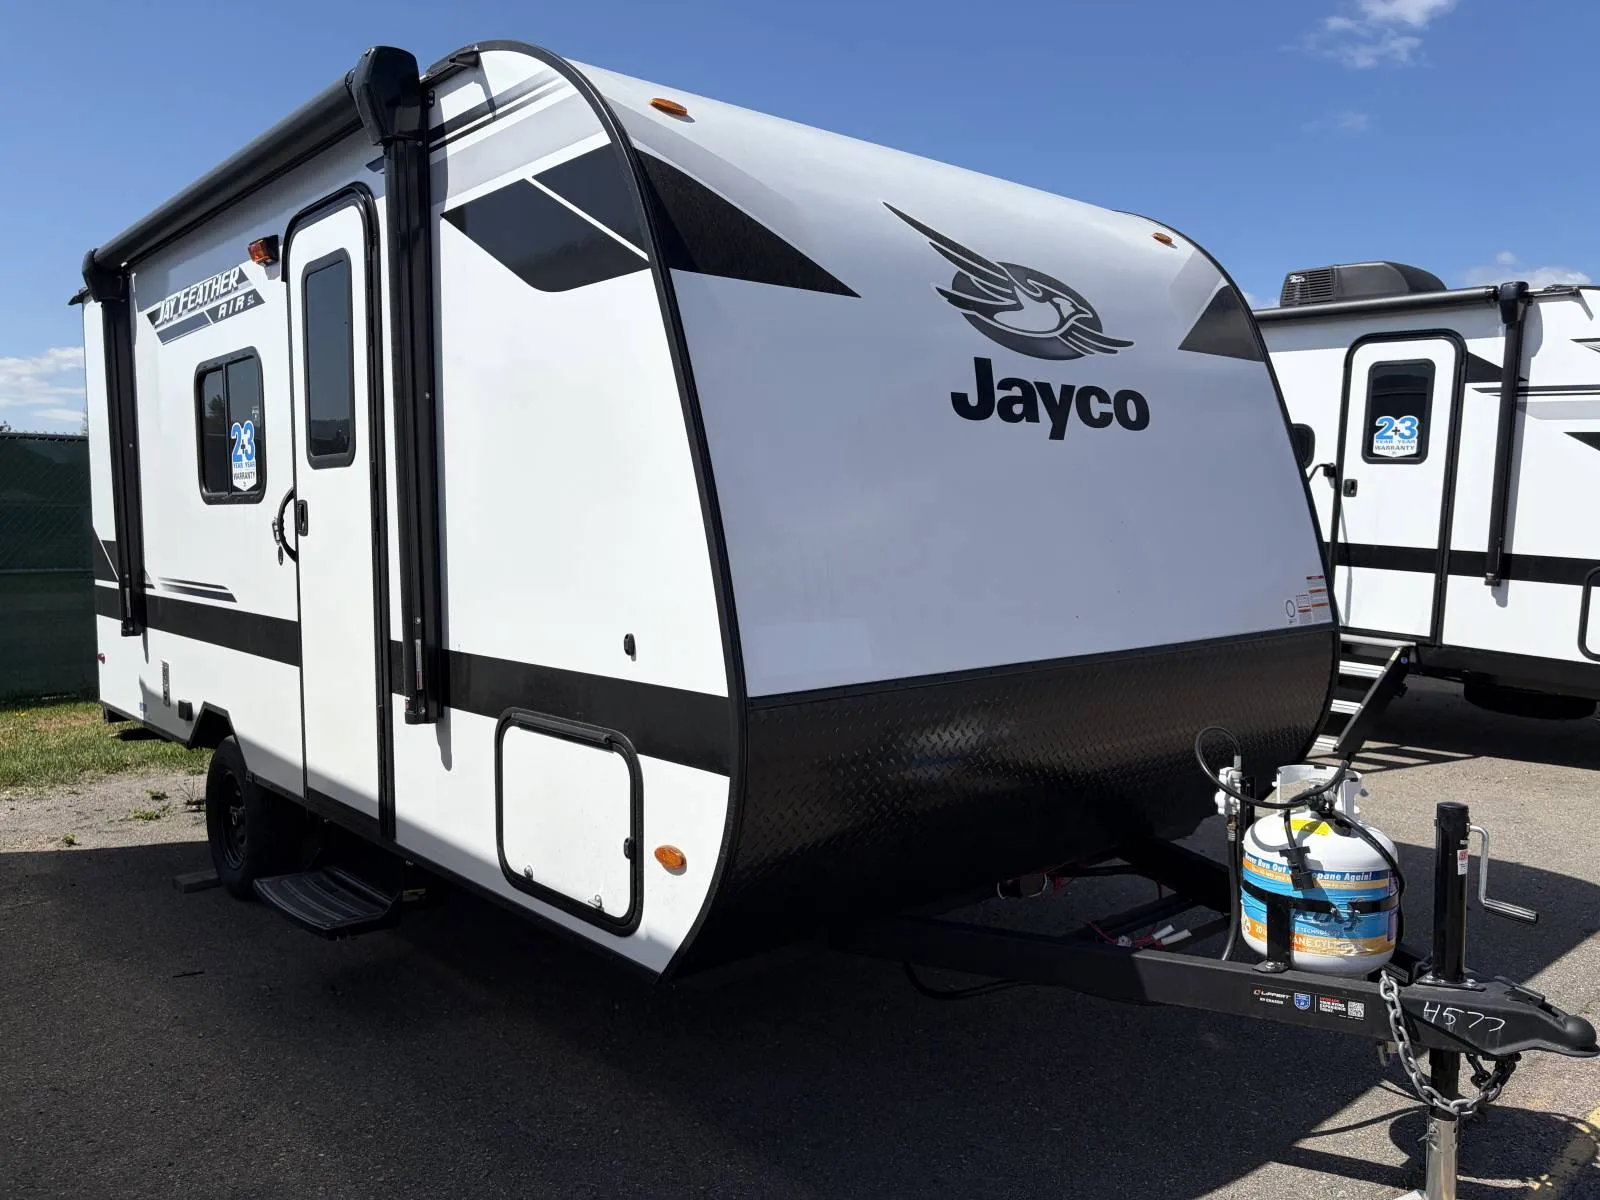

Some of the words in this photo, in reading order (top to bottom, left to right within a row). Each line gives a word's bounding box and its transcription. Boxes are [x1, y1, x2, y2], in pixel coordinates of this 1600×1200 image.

[155, 296, 179, 326] JAY
[178, 266, 240, 314] FEATHER
[218, 296, 244, 319] AIR
[950, 356, 1150, 441] Jayco
[233, 471, 255, 480] WARRANTY
[1258, 859, 1270, 869] Run
[1273, 863, 1287, 873] Out
[1344, 871, 1372, 882] Again!
